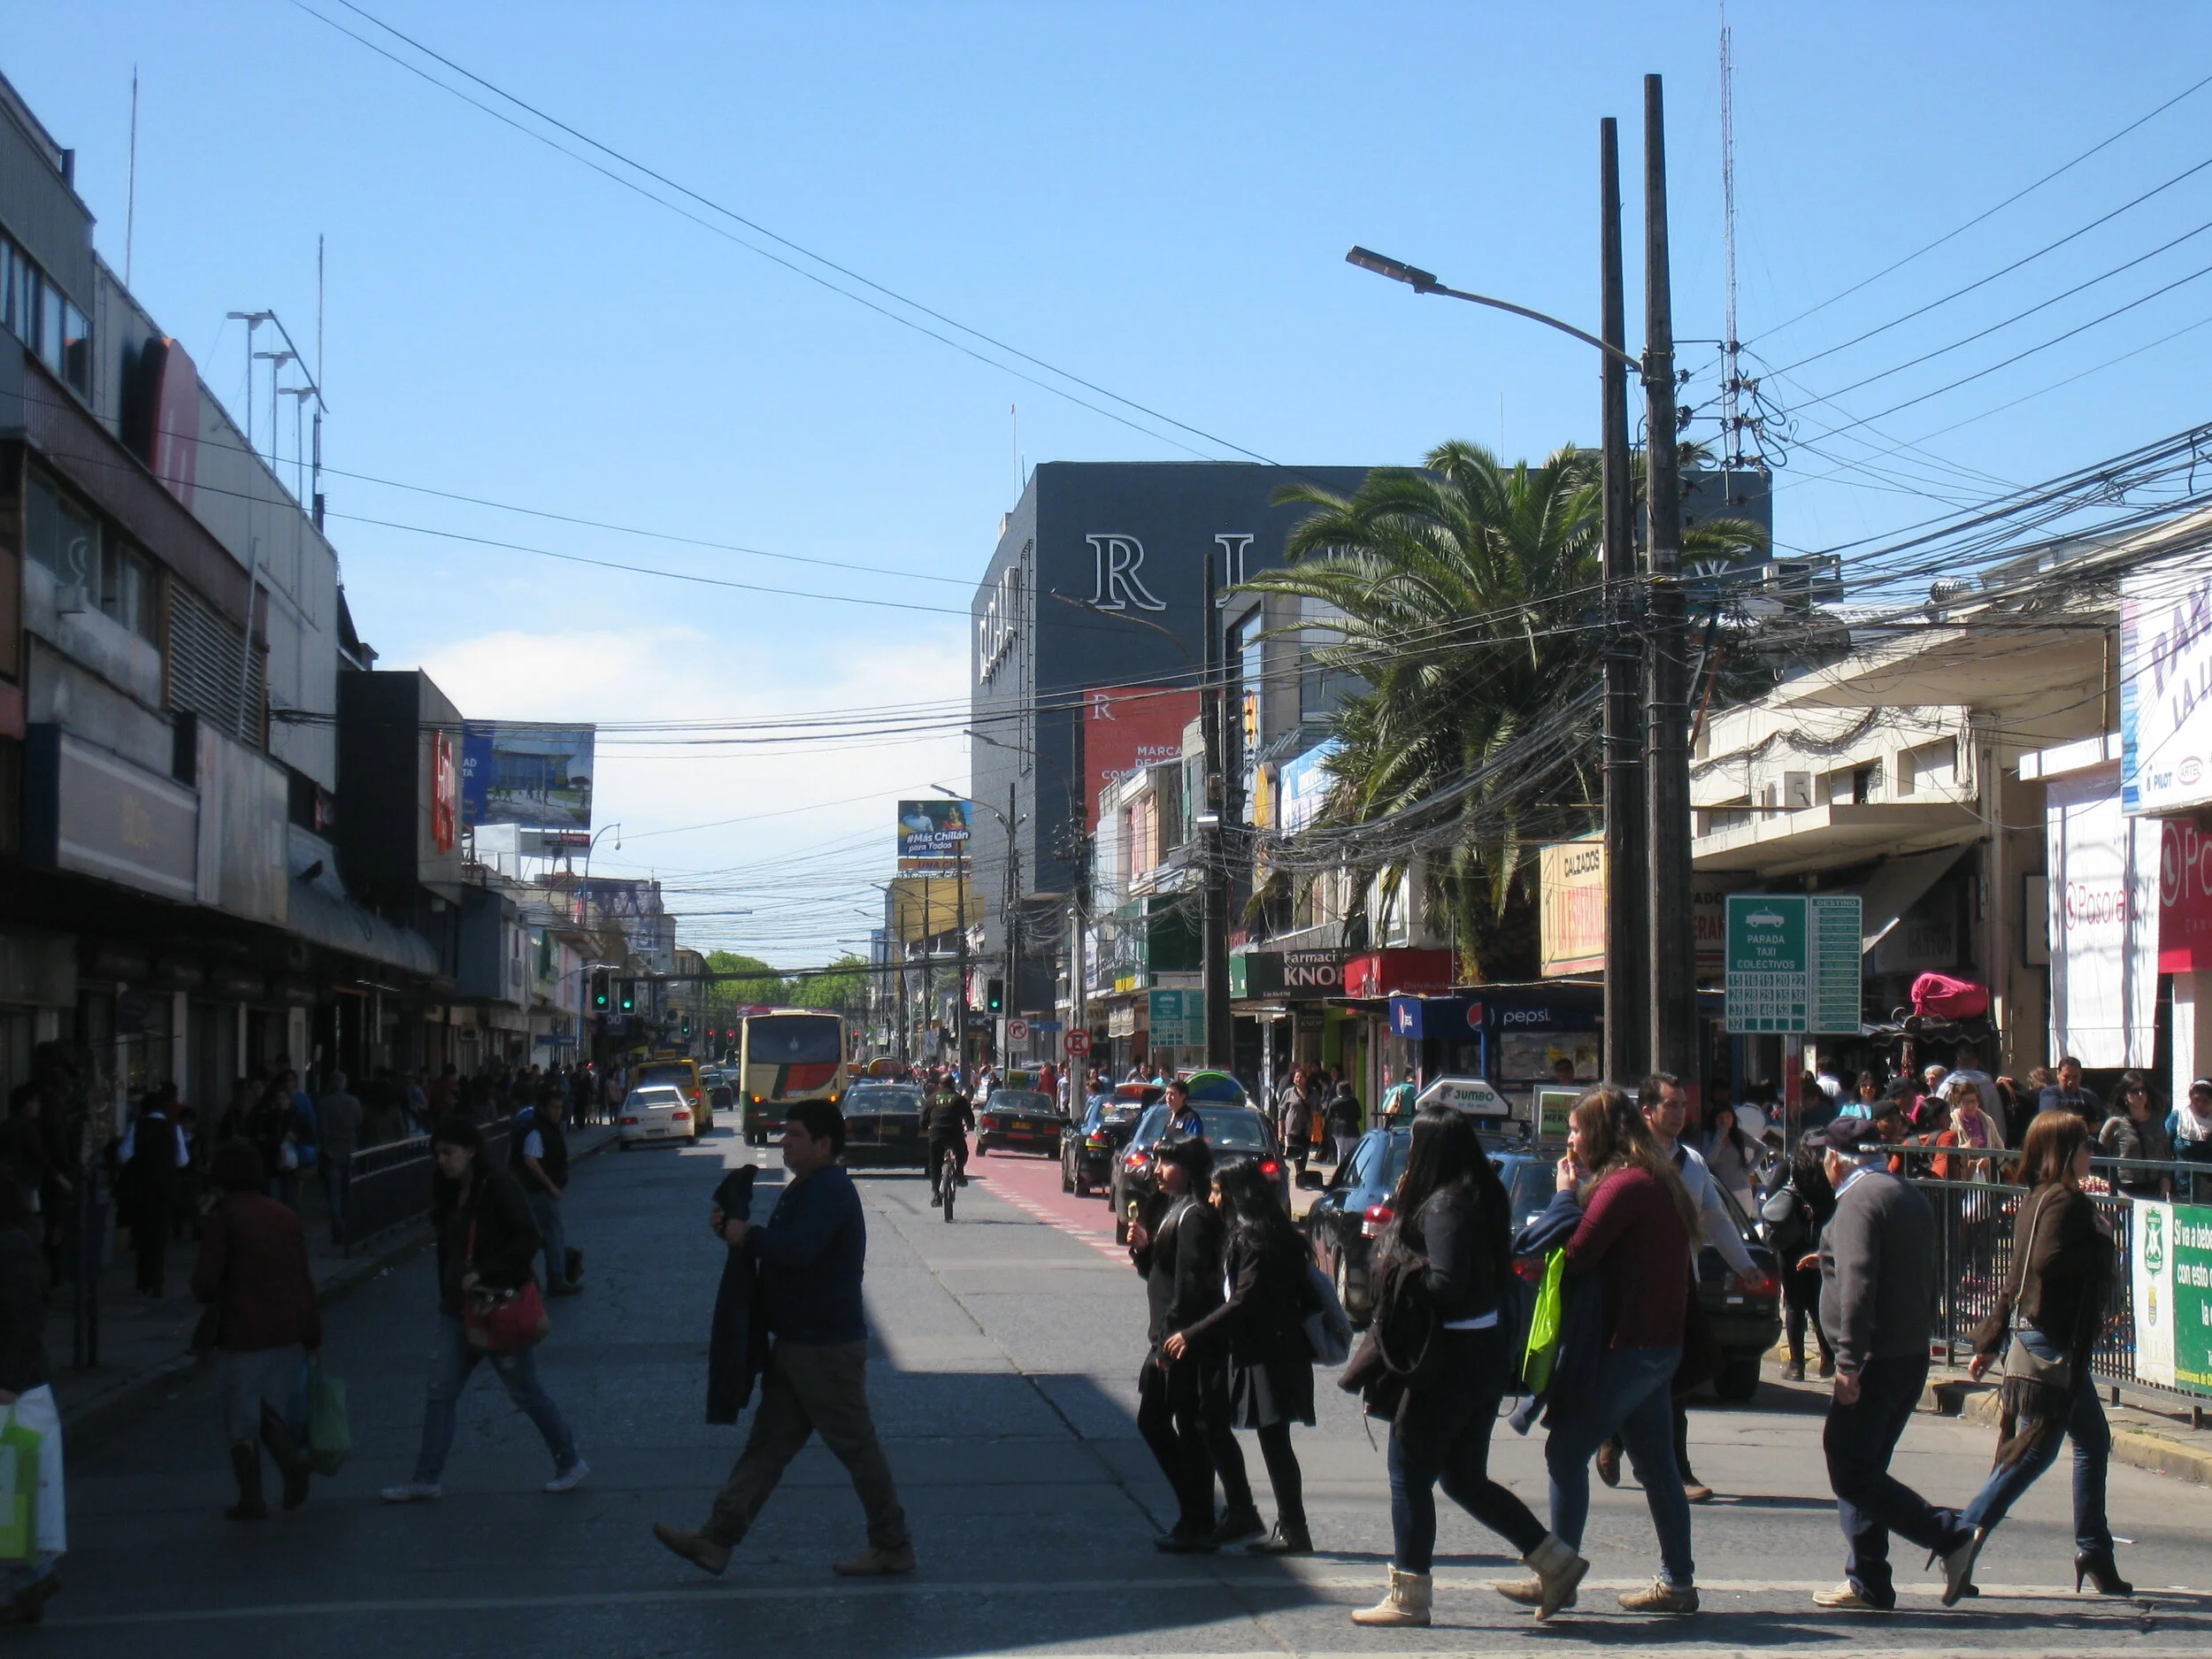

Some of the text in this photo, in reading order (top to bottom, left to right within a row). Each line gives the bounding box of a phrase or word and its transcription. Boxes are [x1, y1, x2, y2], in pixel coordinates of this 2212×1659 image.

[1093, 695, 1115, 720] R
[2180, 764, 2200, 779] ARTEL
[2154, 772, 2172, 790] PILOT
[907, 830, 968, 843] #Más Chillán
[909, 841, 952, 853] para Todos
[1564, 849, 1600, 878] CALZADOS
[2078, 886, 2139, 926] Pasarea
[1756, 948, 1776, 956] TAXI
[1737, 960, 1795, 969] COLECTIVOS
[1731, 976, 1741, 986] 15
[1746, 976, 1756, 986] 16
[1778, 976, 1788, 986] 20
[1793, 976, 1803, 986] 22
[1731, 990, 1741, 1001] 26
[1746, 990, 1756, 1001] 28
[1778, 990, 1788, 1001] 35
[1793, 990, 1803, 1001] 36
[1503, 1008, 1548, 1025] pepsi
[1454, 1090, 1494, 1102] JUMBO
[2177, 1262, 2208, 1287] con esto
[2200, 1299, 2209, 1326] la
